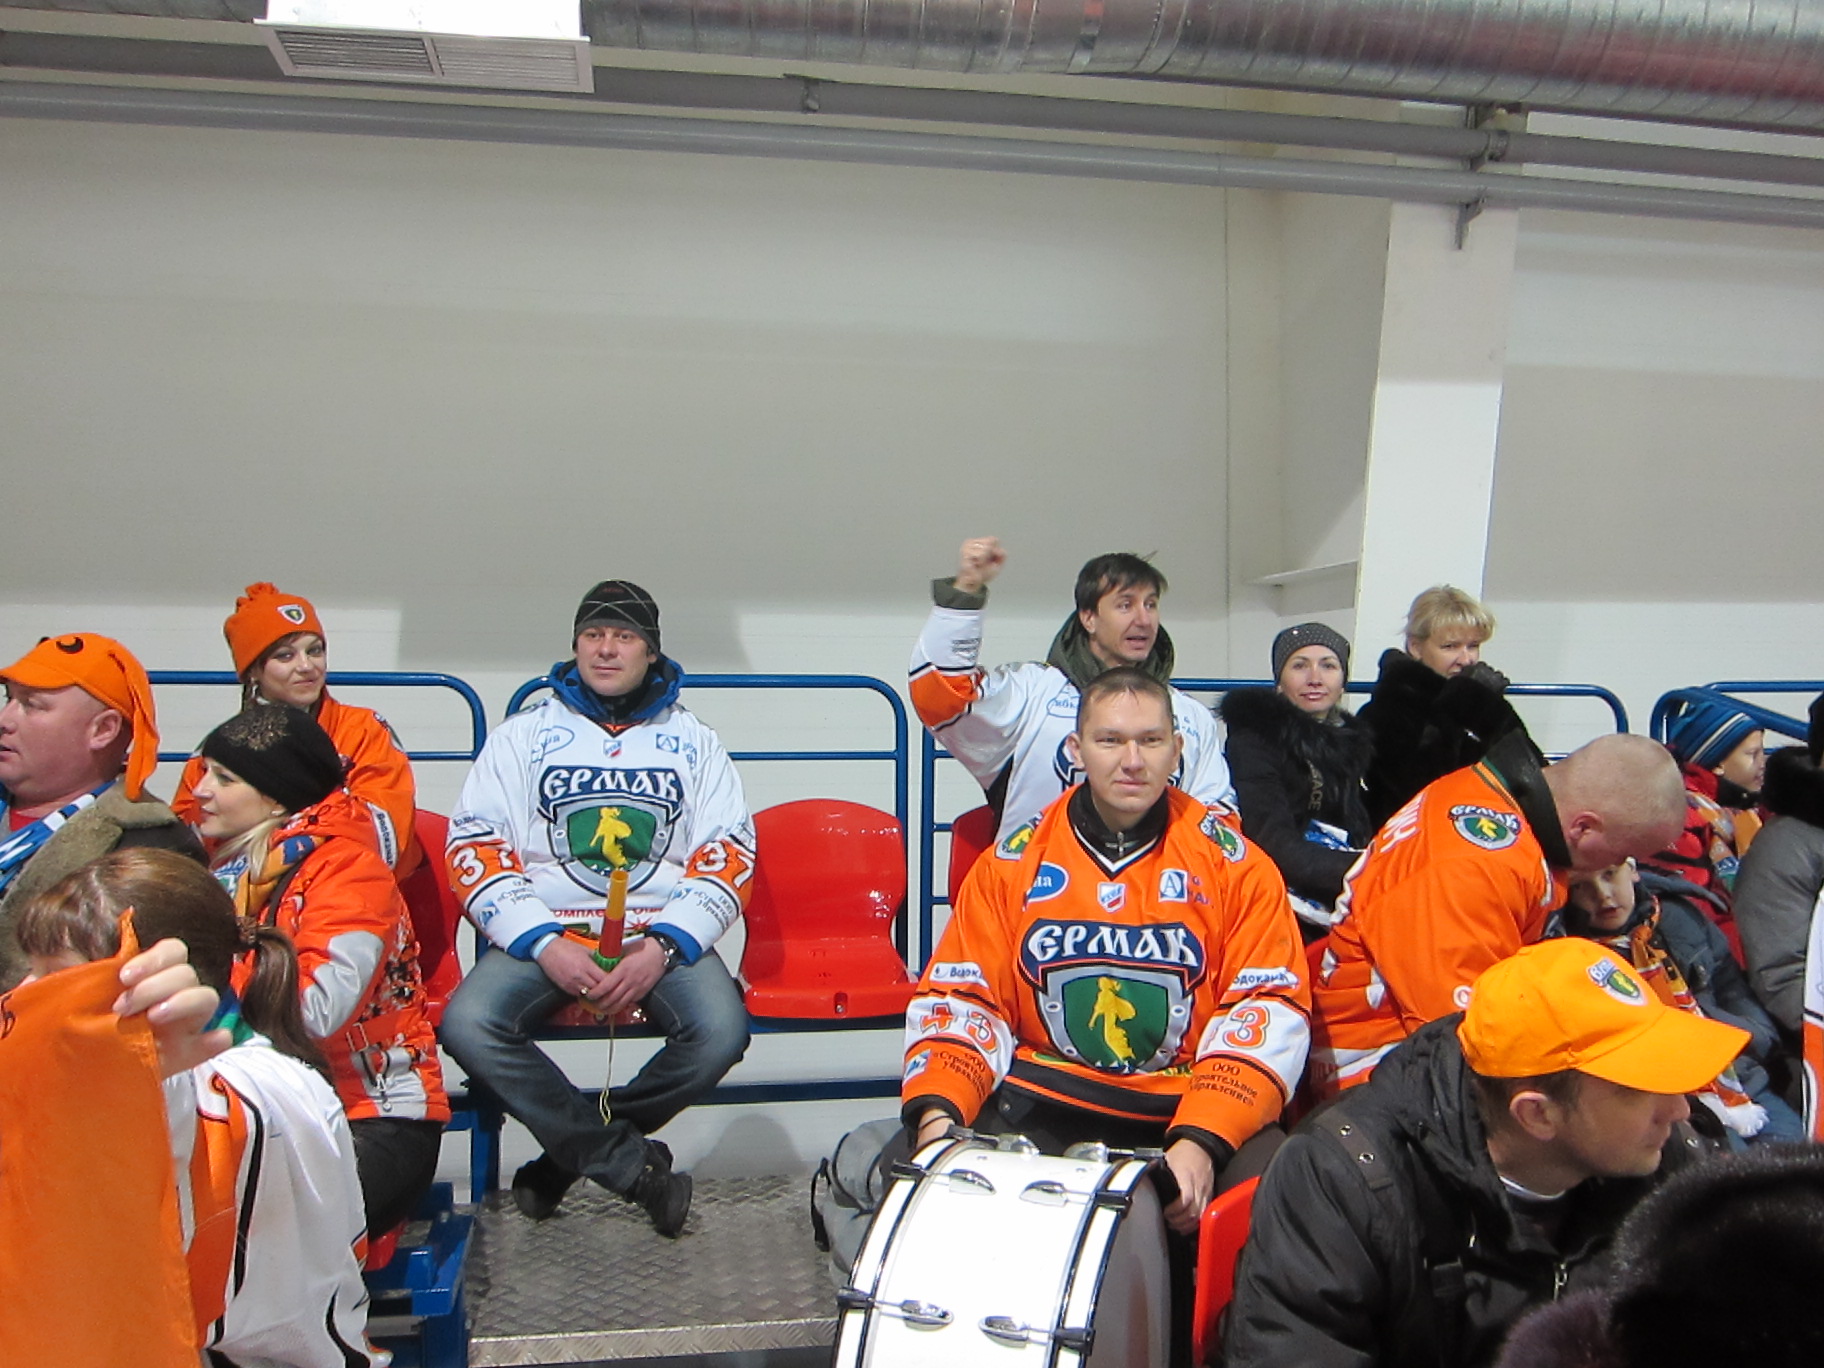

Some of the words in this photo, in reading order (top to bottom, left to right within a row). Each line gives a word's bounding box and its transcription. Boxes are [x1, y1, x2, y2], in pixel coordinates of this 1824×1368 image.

[543, 768, 679, 802] ЕРМАК
[1450, 805, 1518, 829] ЕРМАК
[695, 841, 755, 889] 37
[1028, 925, 1198, 967] ЕРМАК
[1206, 1005, 1271, 1049] 3
